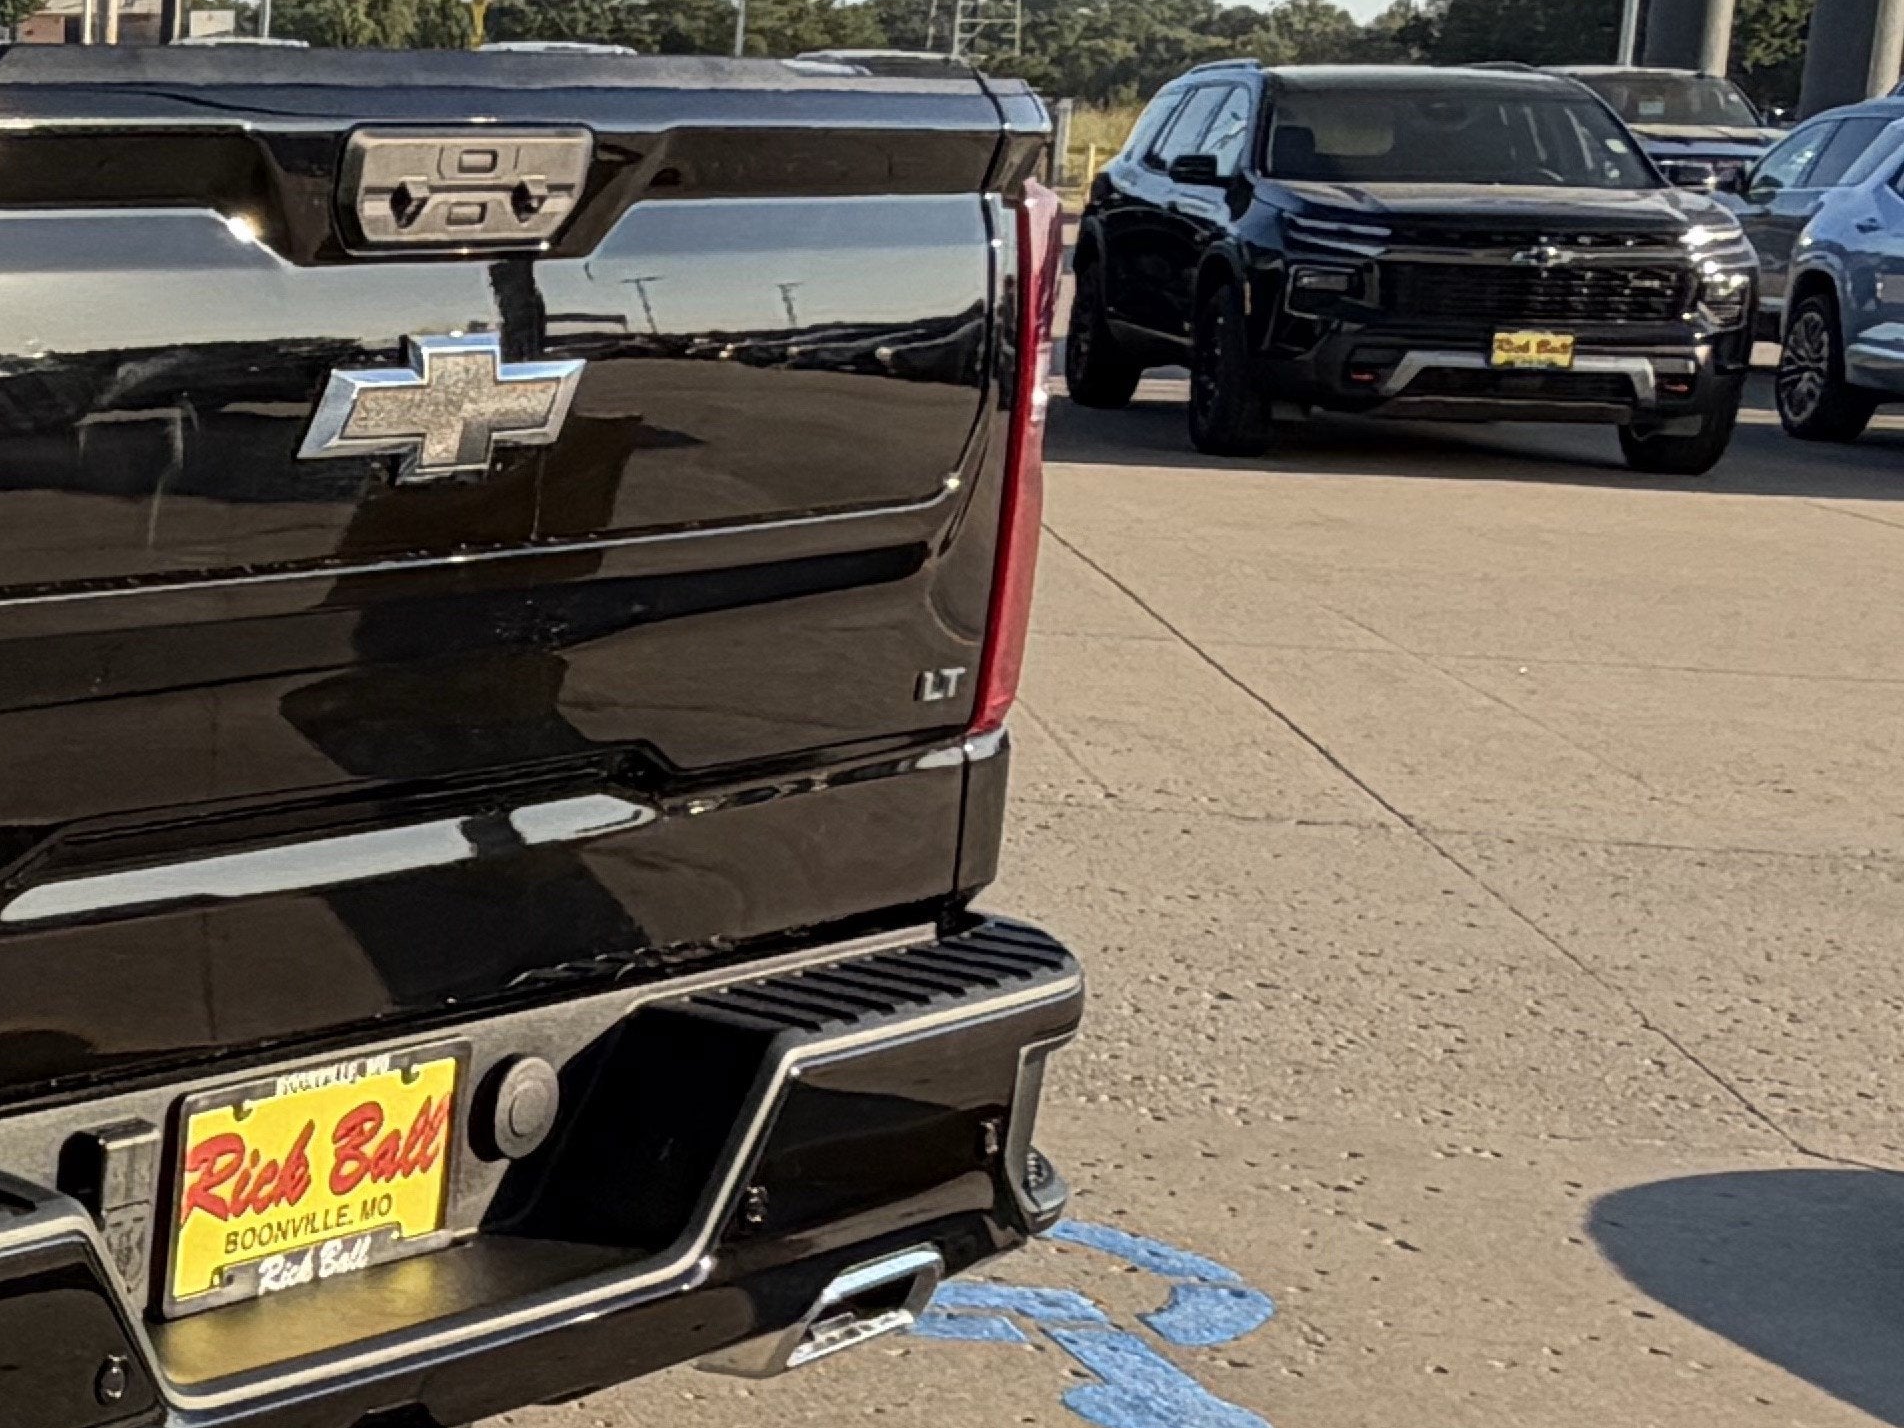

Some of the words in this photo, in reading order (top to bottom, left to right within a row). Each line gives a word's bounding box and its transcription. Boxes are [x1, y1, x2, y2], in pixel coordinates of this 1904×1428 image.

[921, 666, 967, 702] LT
[180, 1118, 316, 1228] Rick
[329, 1091, 453, 1196] Ball
[360, 1193, 393, 1222] MO
[258, 1246, 314, 1295] Rick
[318, 1236, 372, 1278] Ball
